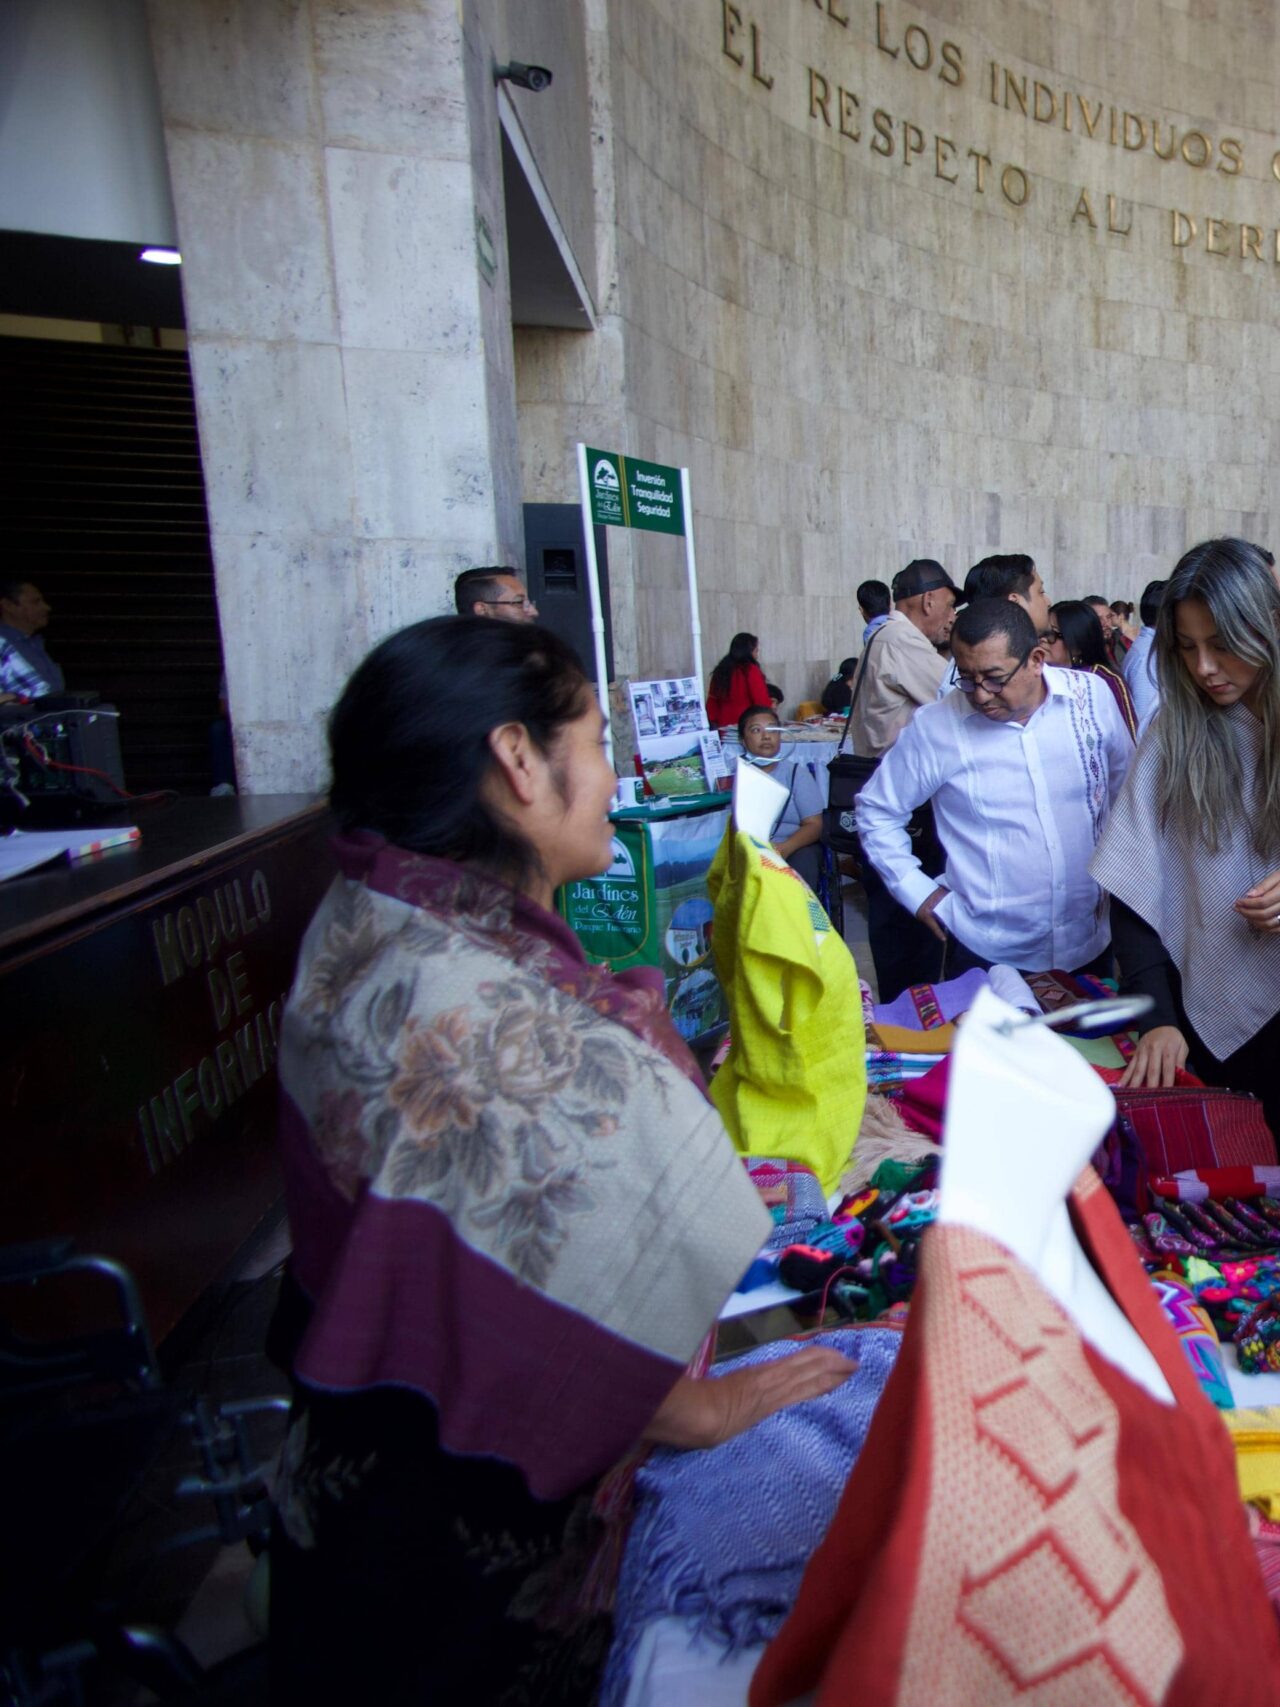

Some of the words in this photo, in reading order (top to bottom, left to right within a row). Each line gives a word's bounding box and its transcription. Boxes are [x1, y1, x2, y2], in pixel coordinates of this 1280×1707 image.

[721, 0, 775, 91] EL
[808, 66, 1030, 207] RESPETO
[1070, 186, 1132, 236] AL
[876, 1, 966, 88] LOS
[988, 61, 1245, 177] INDIVIDUOS
[630, 483, 674, 503] Tranquilidad
[636, 501, 671, 518] Seguridad
[151, 868, 272, 987] MODULO
[572, 882, 640, 902] Jardines
[207, 951, 254, 1032] DE
[137, 992, 288, 1178] INFORMAC
